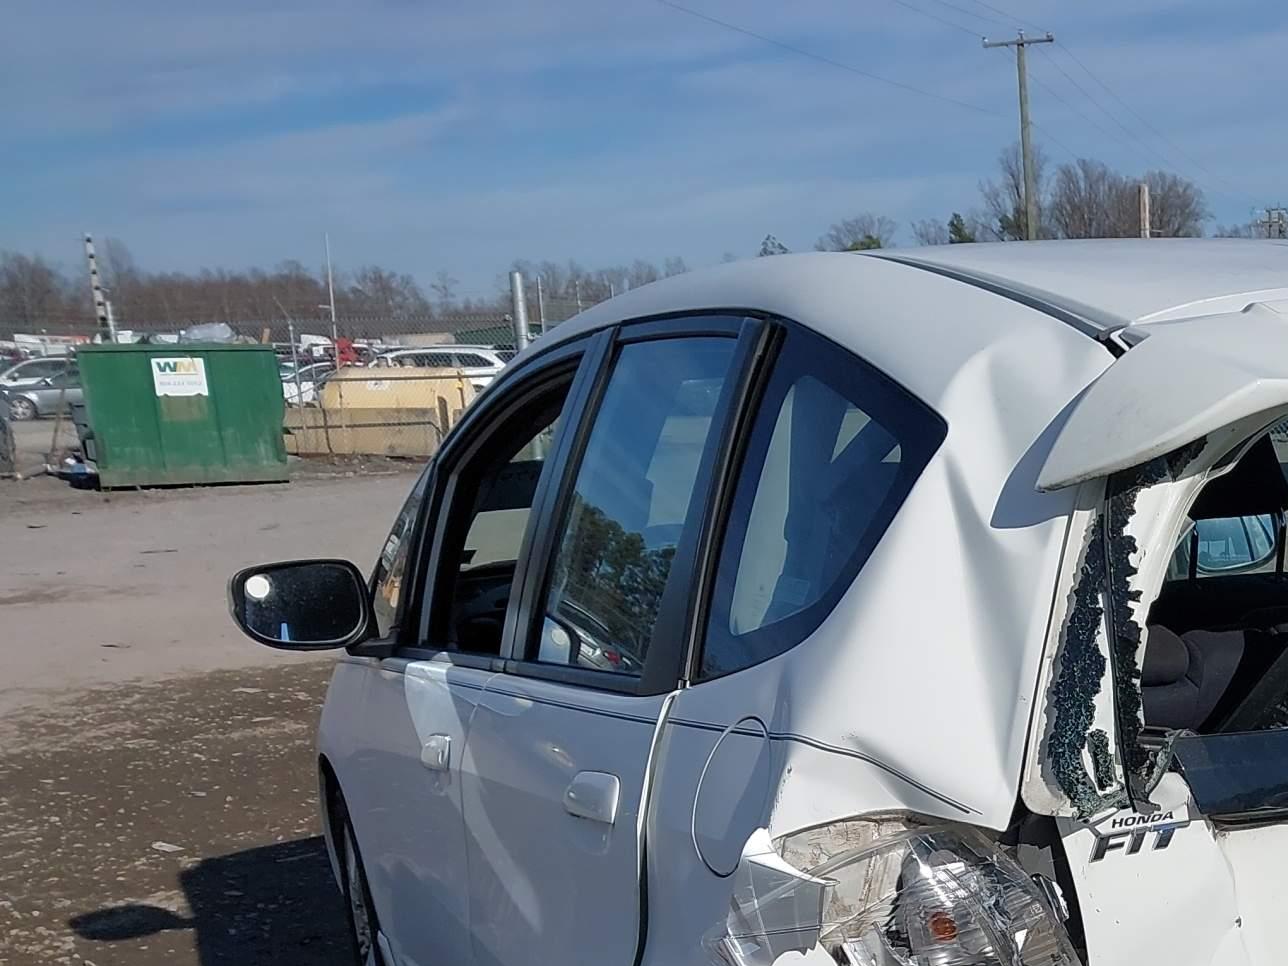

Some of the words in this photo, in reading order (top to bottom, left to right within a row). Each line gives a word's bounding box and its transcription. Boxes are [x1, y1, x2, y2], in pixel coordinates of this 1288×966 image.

[155, 361, 198, 373] WM
[1111, 811, 1174, 829] HONDA
[1088, 821, 1191, 864] FIT
